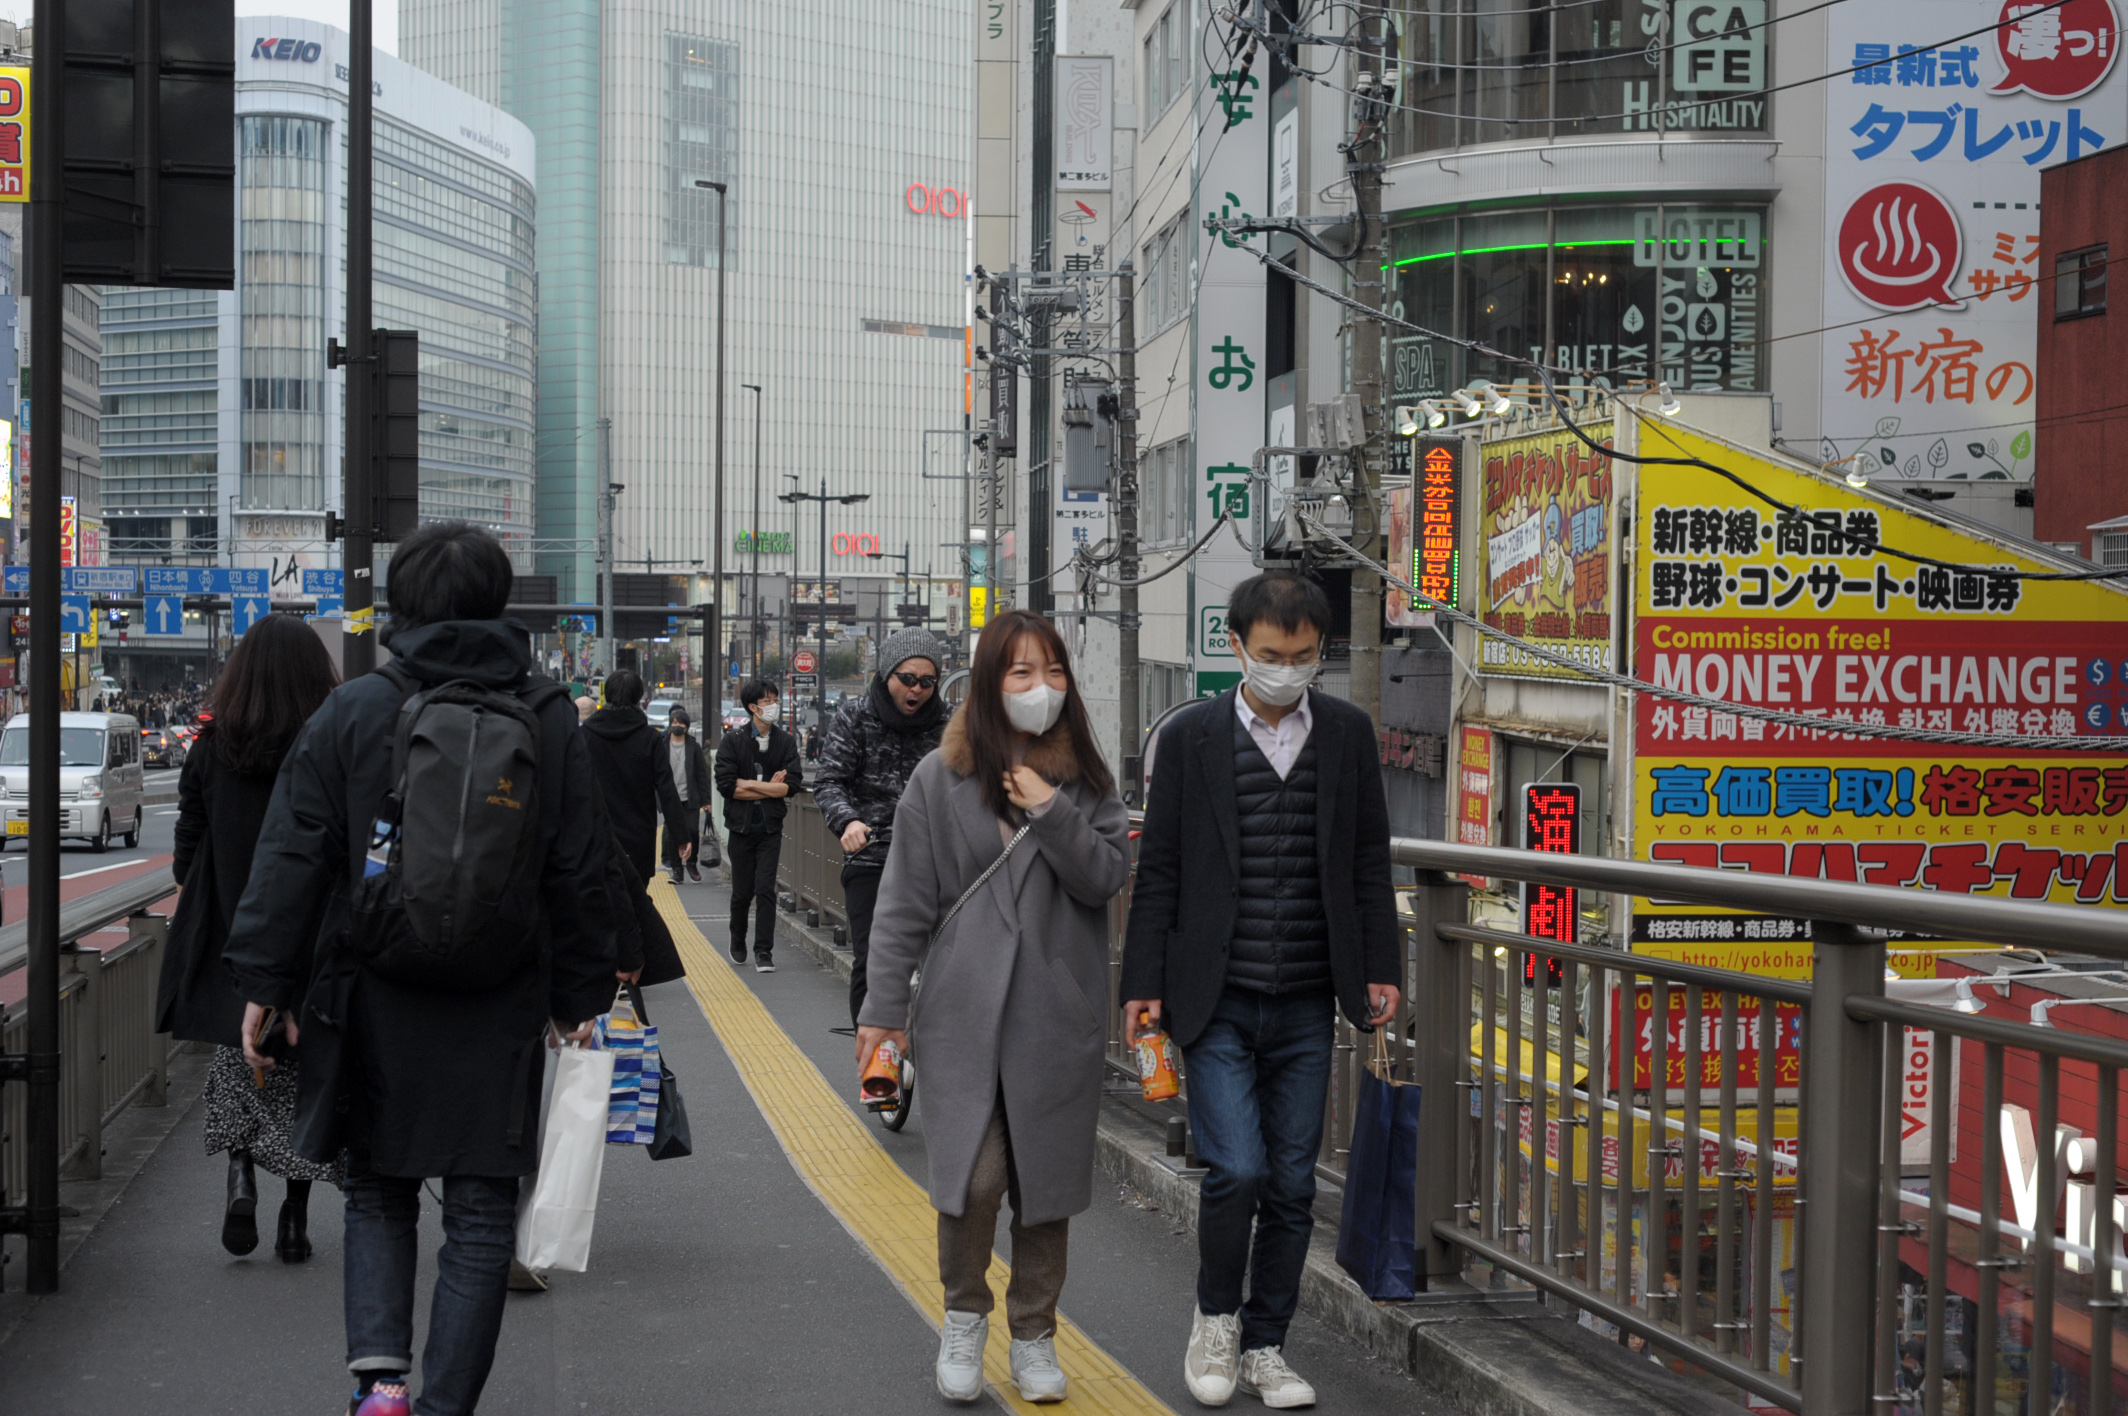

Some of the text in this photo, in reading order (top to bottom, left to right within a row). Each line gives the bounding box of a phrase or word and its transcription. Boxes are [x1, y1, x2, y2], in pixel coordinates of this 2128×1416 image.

[251, 37, 322, 63] KEIO
[1851, 43, 1980, 88] 最新式
[1850, 102, 2106, 166] タブレット
[1644, 217, 1756, 262] HOTEL
[1968, 269, 2041, 302] サウ
[1730, 273, 1757, 390] AMENITIES
[1394, 345, 1435, 390] SPA
[1530, 344, 1612, 372] TBLET
[1845, 328, 2034, 405] 新宿の
[246, 519, 309, 535] FOREVER
[1651, 507, 1879, 557] 新幹線・商品券
[149, 571, 189, 584] 日本橋
[201, 575, 211, 585] 20
[229, 571, 260, 584] 四谷
[271, 554, 299, 587] LA
[306, 572, 336, 585] 渋谷
[150, 584, 188, 592] Nihonbashi
[230, 584, 259, 594] Yotsuya
[307, 586, 335, 594] Shibuya
[1651, 562, 2022, 612] 野球・コンサート・映画券
[1652, 624, 1891, 650] Commission free!
[1652, 653, 2078, 704] MONEY EXCHANGE
[1466, 735, 1485, 749] MONEY
[1462, 750, 1490, 769] EXCHANGE
[1654, 824, 1845, 836] YOKOHAMA
[1875, 824, 1998, 836] TICKET
